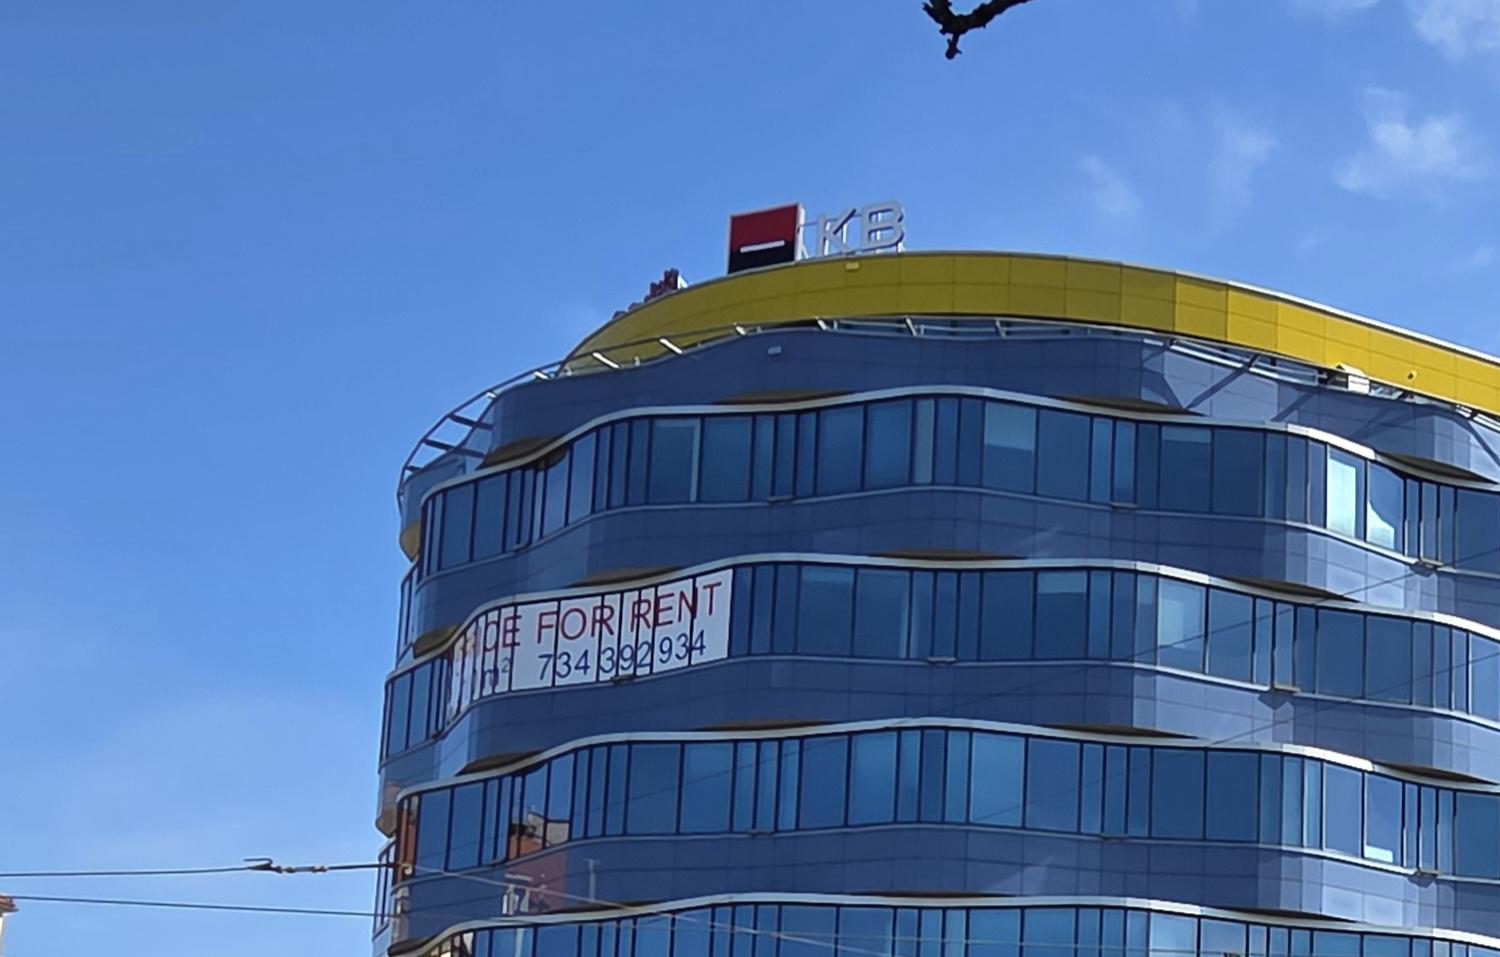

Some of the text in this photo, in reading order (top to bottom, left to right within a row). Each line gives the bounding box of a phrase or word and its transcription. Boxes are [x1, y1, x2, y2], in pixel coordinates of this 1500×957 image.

[815, 202, 905, 255] KB
[537, 603, 615, 645] FOR
[630, 581, 722, 633] RENT
[538, 649, 592, 681] 734
[600, 641, 652, 675] 392
[658, 629, 707, 665] 934
